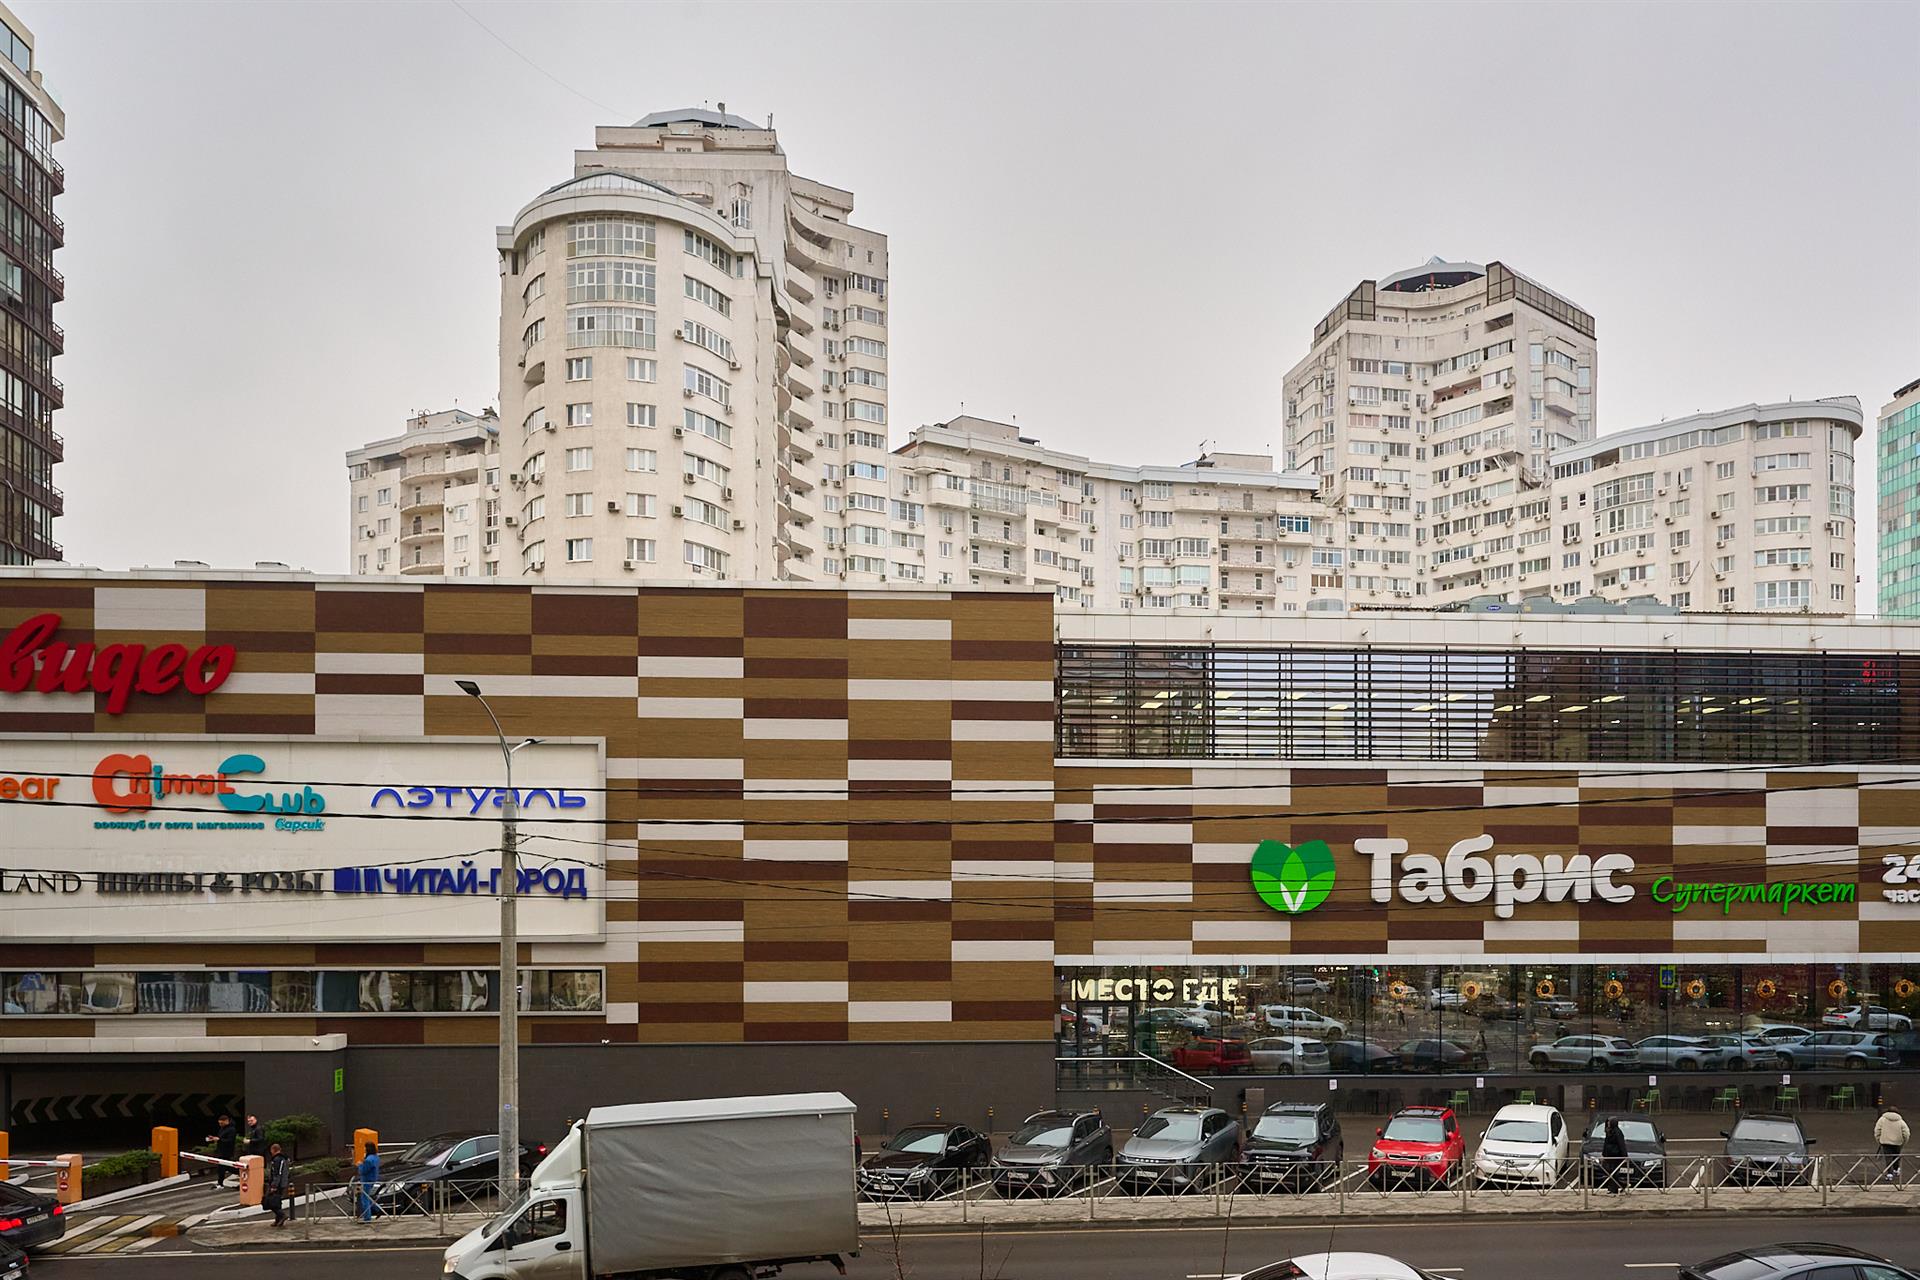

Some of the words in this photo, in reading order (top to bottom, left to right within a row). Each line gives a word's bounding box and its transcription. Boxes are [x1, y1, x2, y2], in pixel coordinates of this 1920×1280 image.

[0, 776, 61, 801] ear
[96, 872, 205, 894] ШИПЫ
[209, 871, 234, 894] &
[240, 872, 324, 894] РОЗЫ
[1354, 834, 1636, 919] Табрис
[1651, 876, 1856, 915] Супермаркет
[1071, 977, 1175, 1002] МЕСТО
